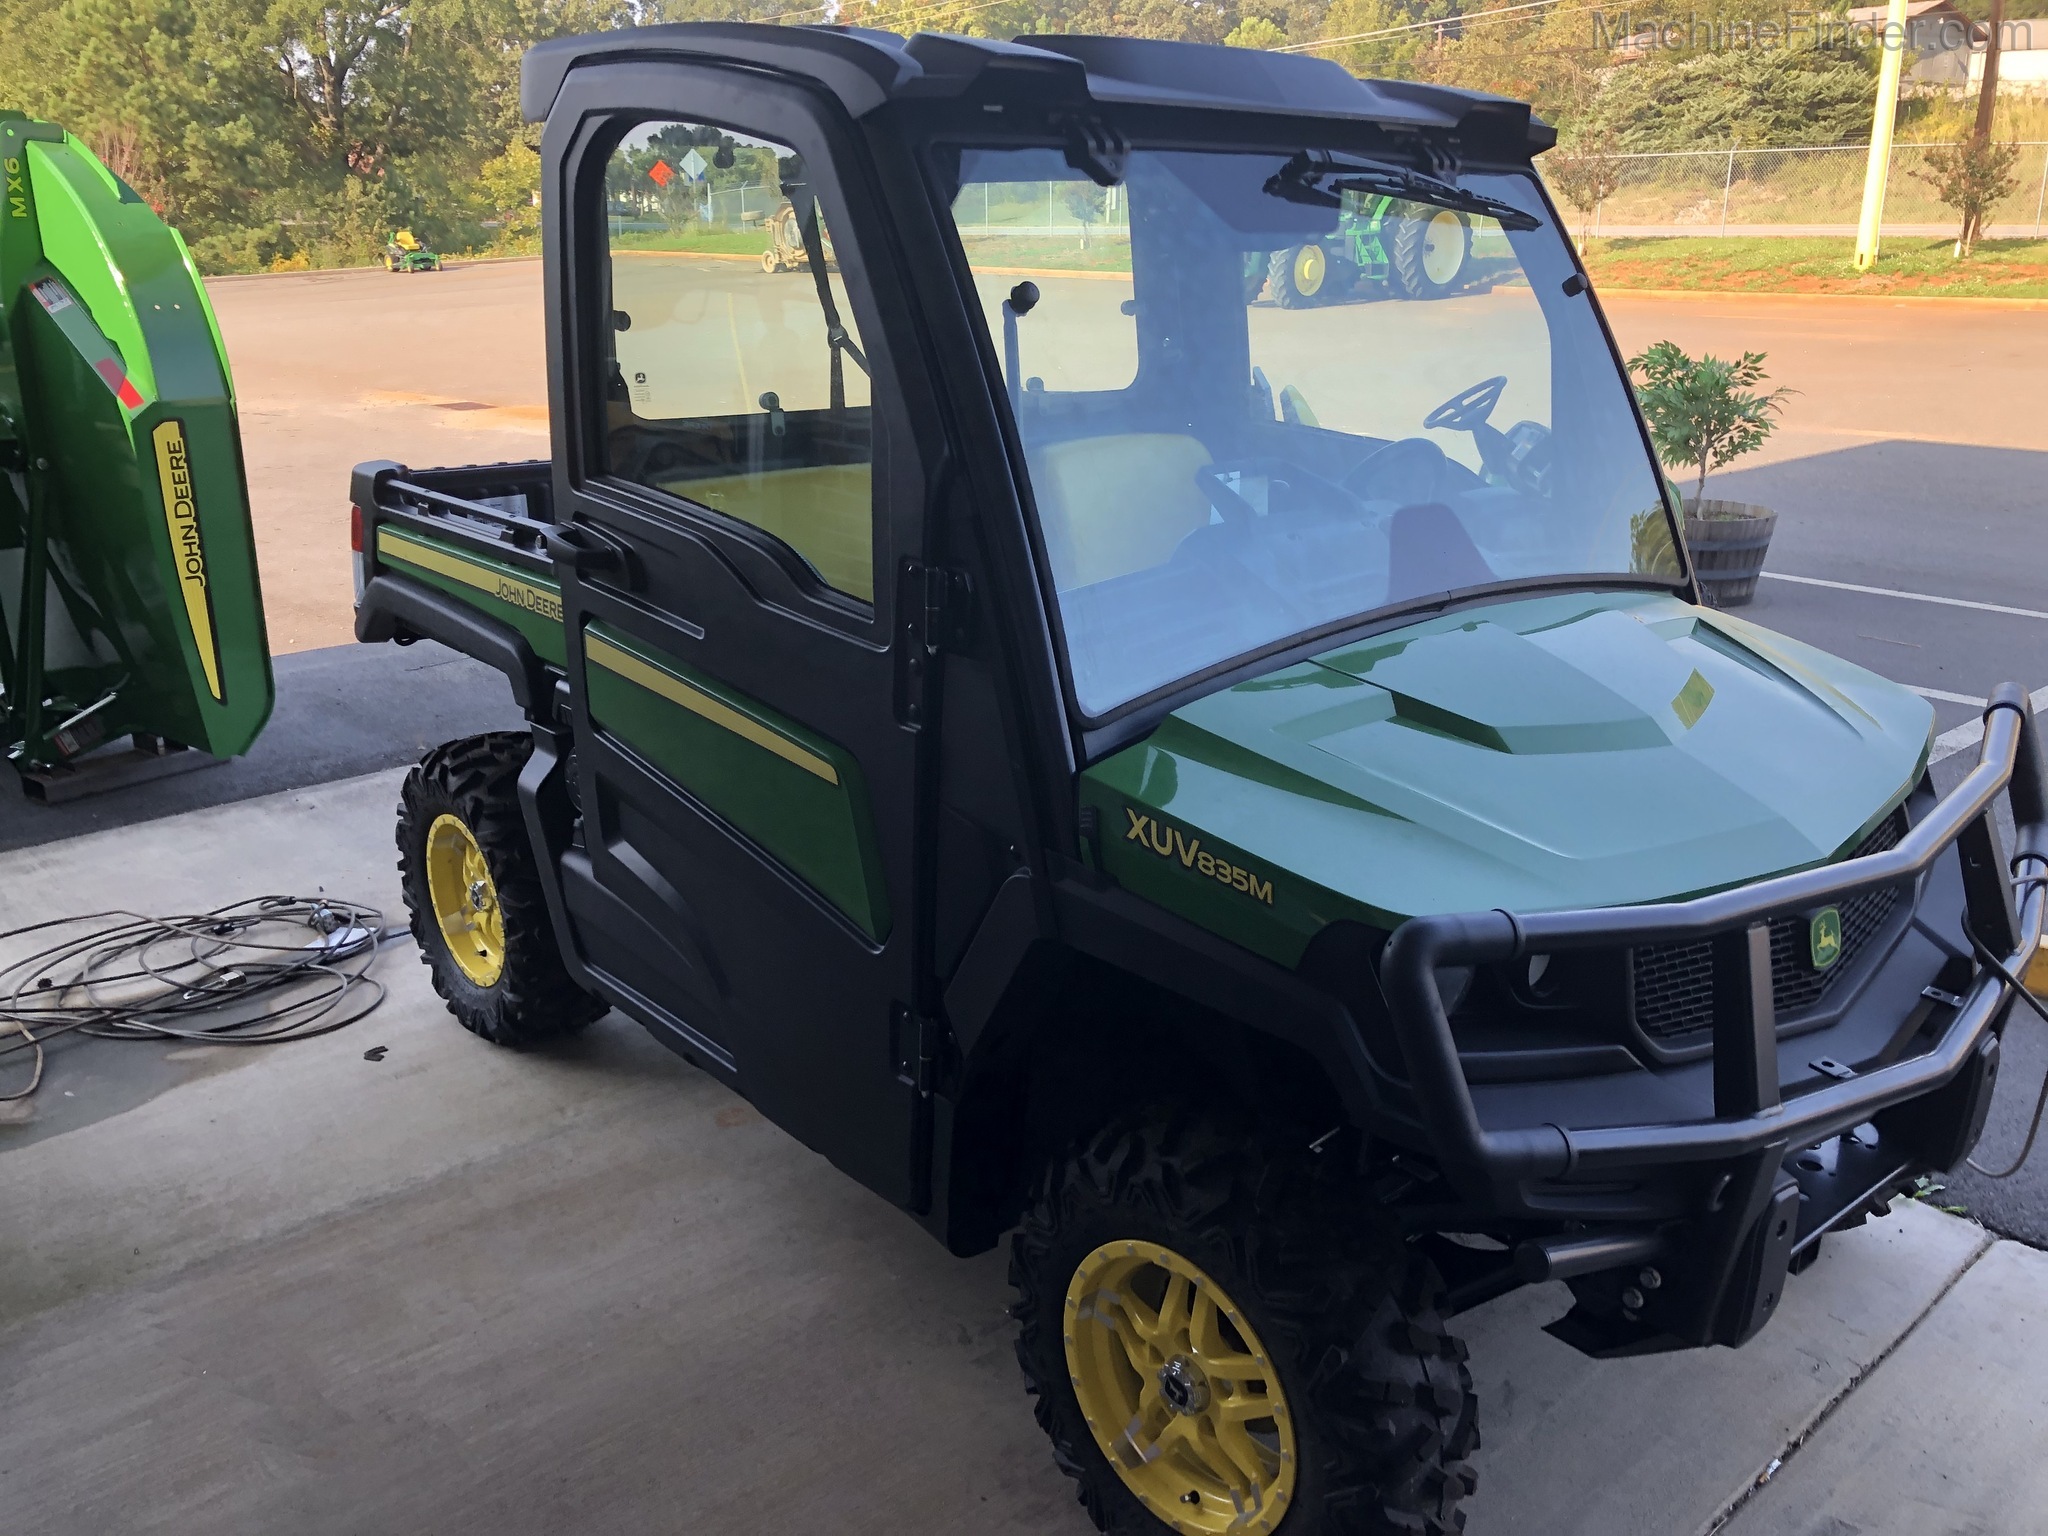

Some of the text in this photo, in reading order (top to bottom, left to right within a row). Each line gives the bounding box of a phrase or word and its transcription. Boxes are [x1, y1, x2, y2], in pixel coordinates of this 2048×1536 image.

[4, 158, 27, 218] MX6
[167, 439, 205, 586] JOHN DEERE
[495, 578, 563, 620] JOHN DEERE
[1126, 807, 1273, 905] XUV835M
